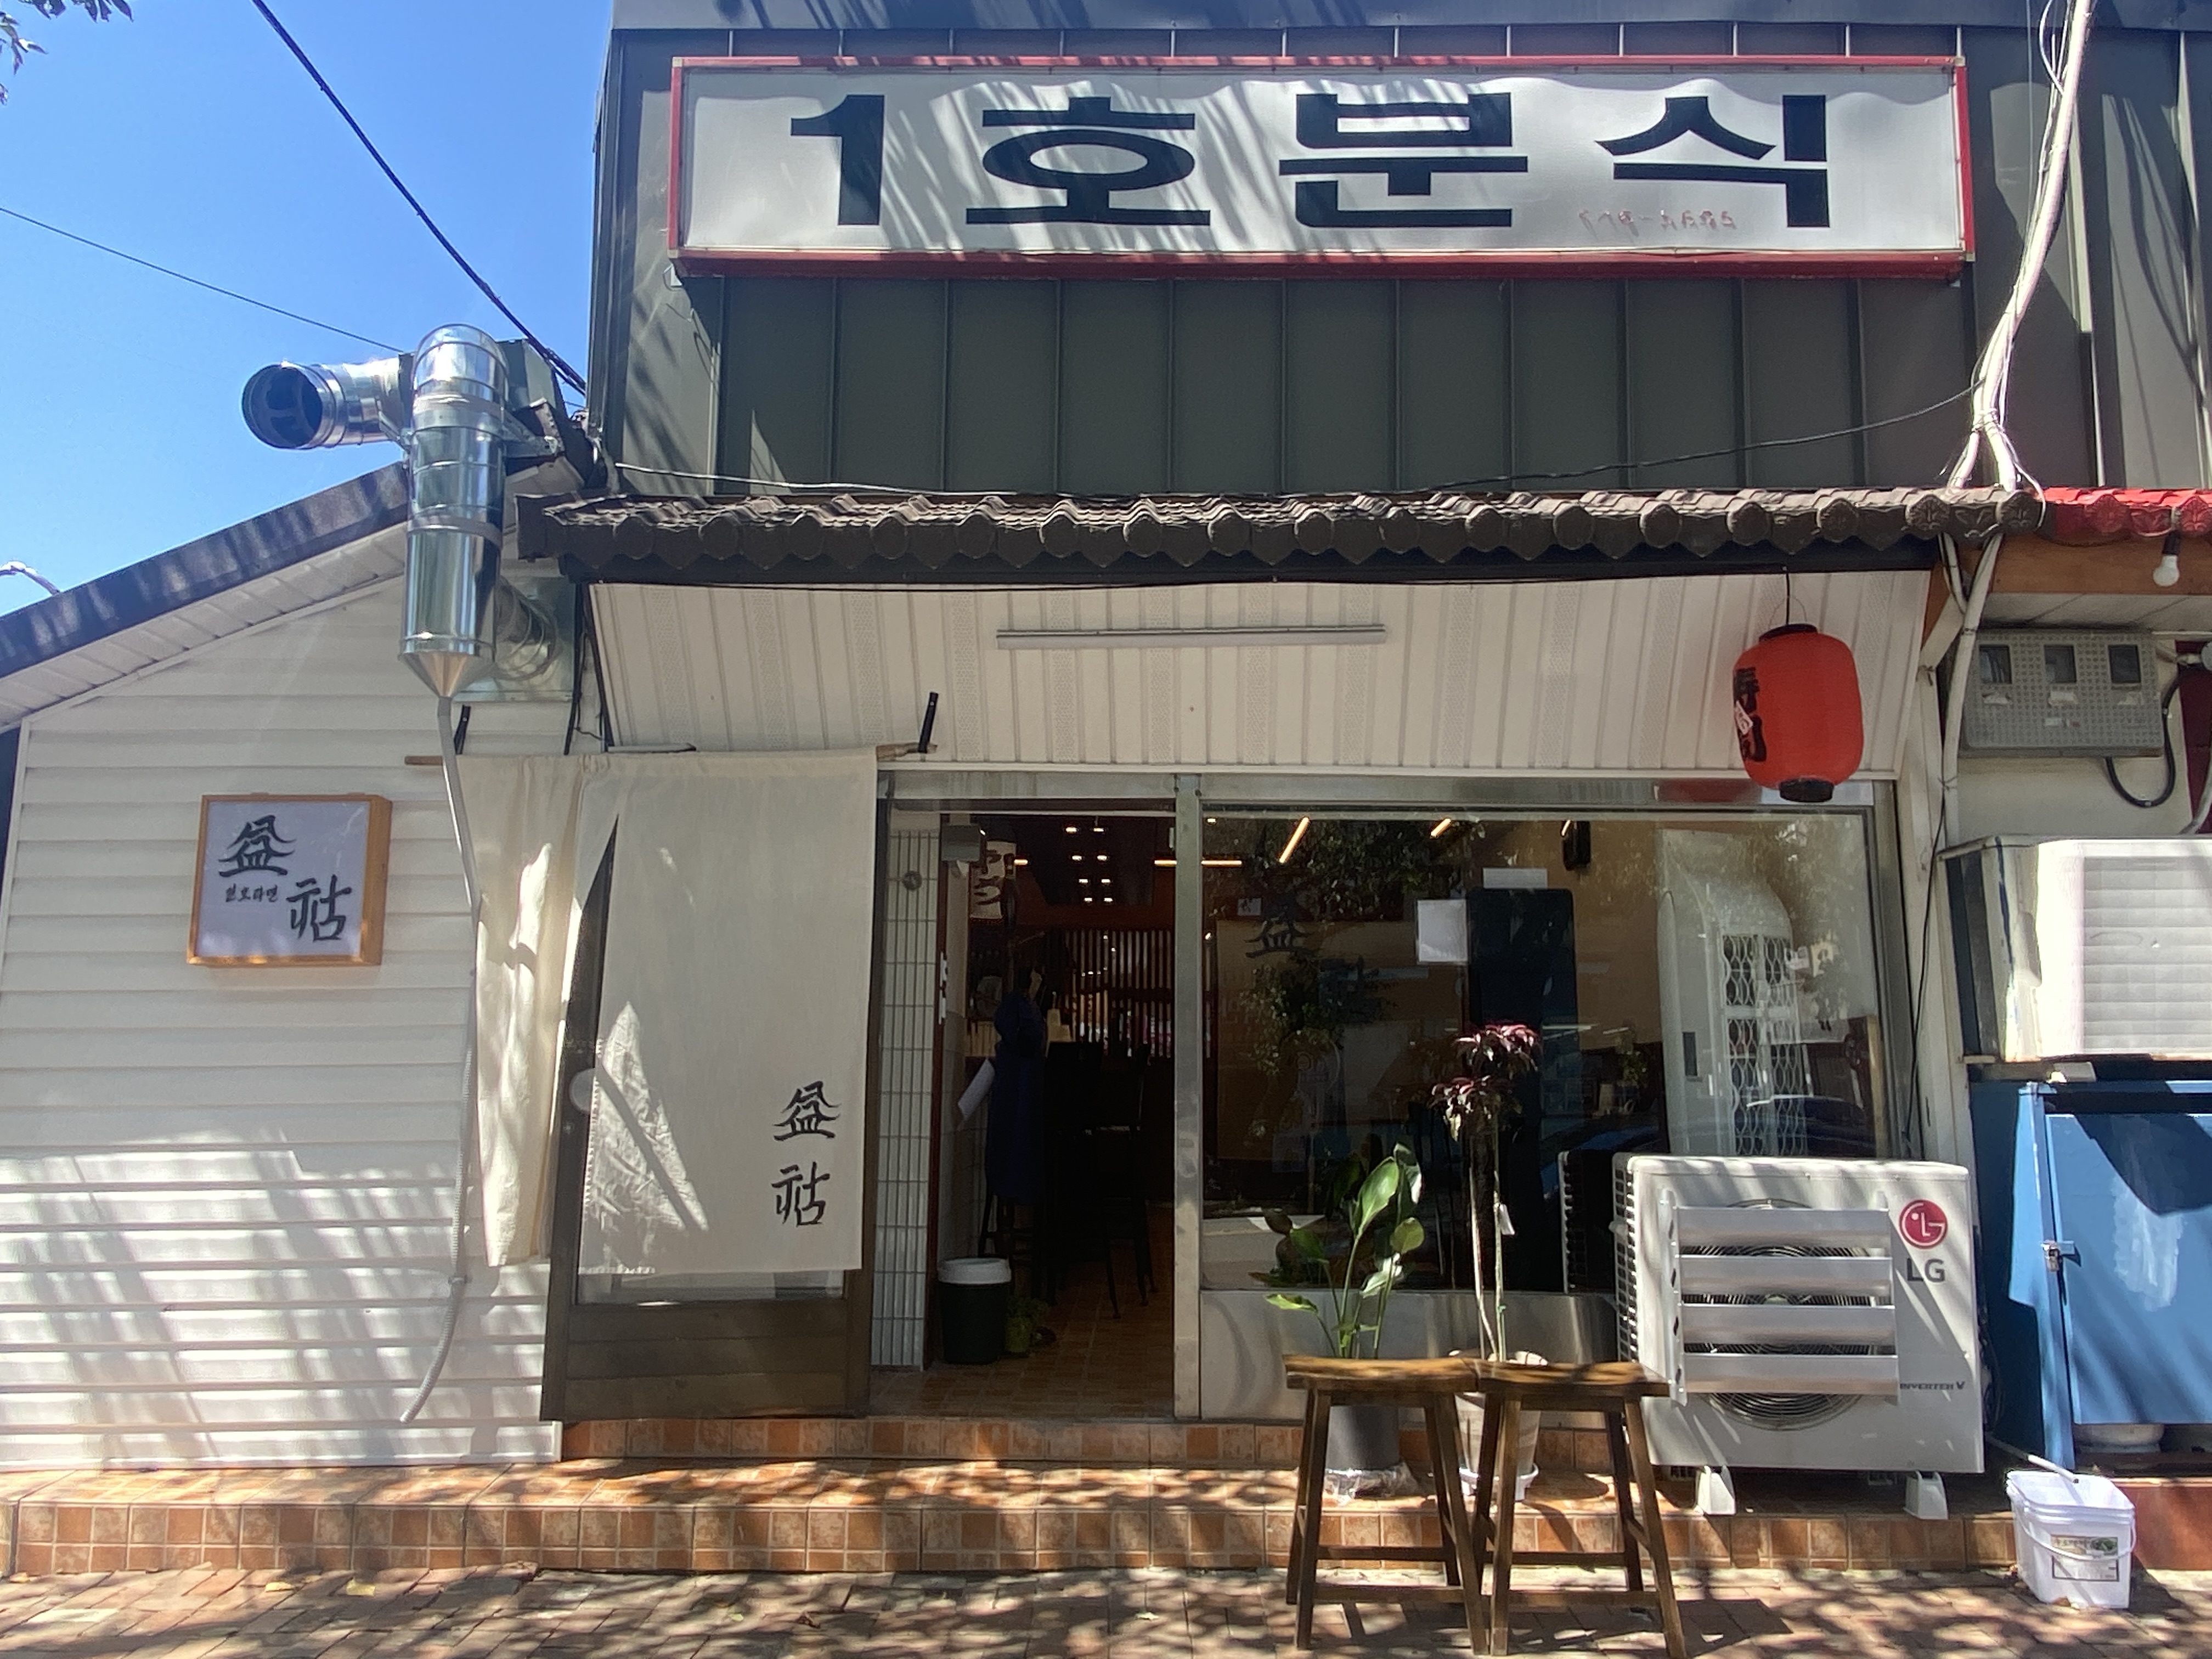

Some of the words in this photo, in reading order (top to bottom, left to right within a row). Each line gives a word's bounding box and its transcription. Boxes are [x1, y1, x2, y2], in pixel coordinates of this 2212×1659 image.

[790, 92, 1831, 228] 1호분식
[1906, 1258, 1946, 1283] LG
[1955, 1381, 1965, 1390] V
